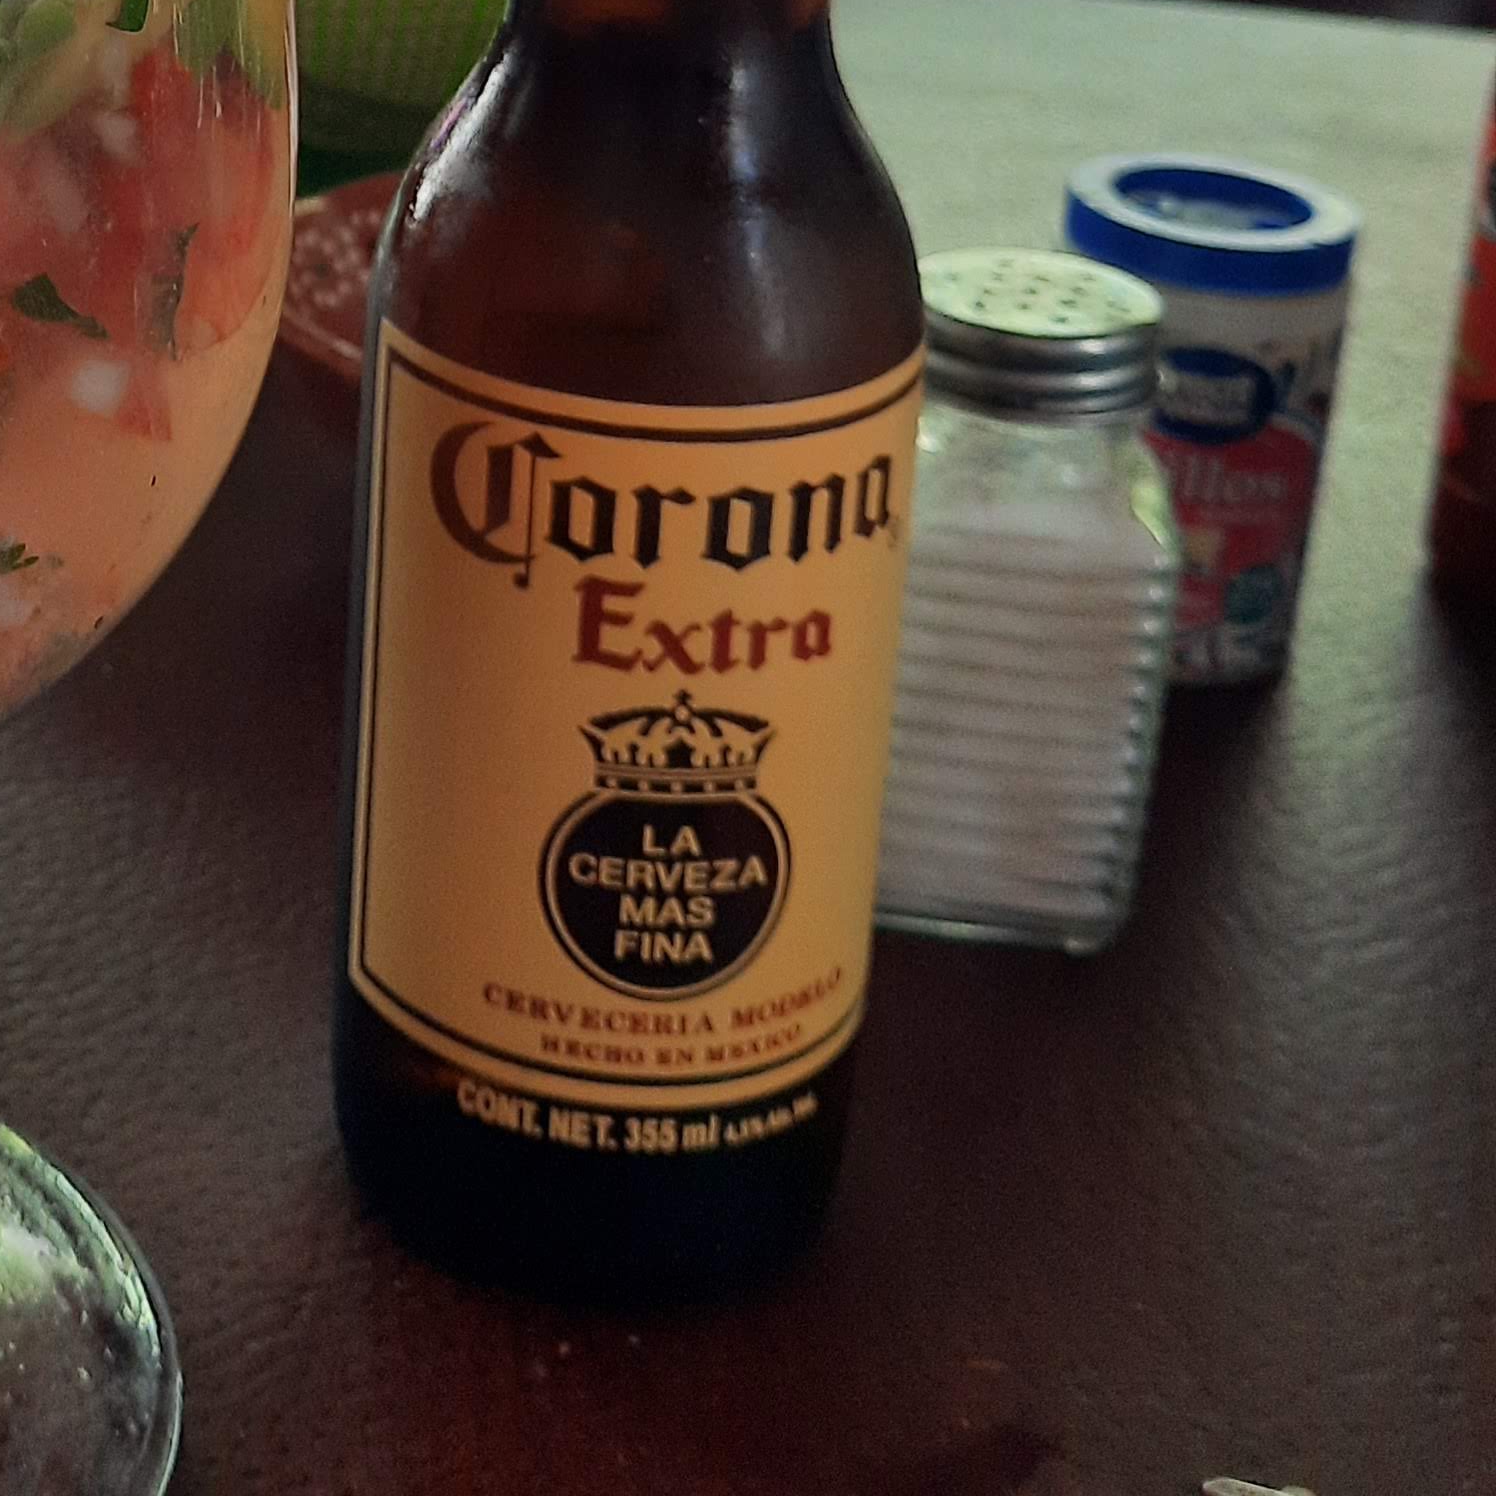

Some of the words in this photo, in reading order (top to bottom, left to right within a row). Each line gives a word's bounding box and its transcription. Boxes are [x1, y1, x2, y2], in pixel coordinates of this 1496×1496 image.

[429, 420, 892, 589] Corona
[572, 575, 832, 676] Extra
[641, 823, 700, 857] LA
[568, 853, 768, 893] CERVEZA
[619, 895, 717, 927] MAS
[613, 930, 713, 965] FINA
[729, 966, 842, 1029] MODELO
[540, 1032, 645, 1065] HECHO
[655, 1046, 694, 1064] EN
[456, 1078, 544, 1140] CONT.
[547, 1106, 618, 1152] NET.
[623, 1117, 678, 1154] 355
[681, 1112, 720, 1149] ml
